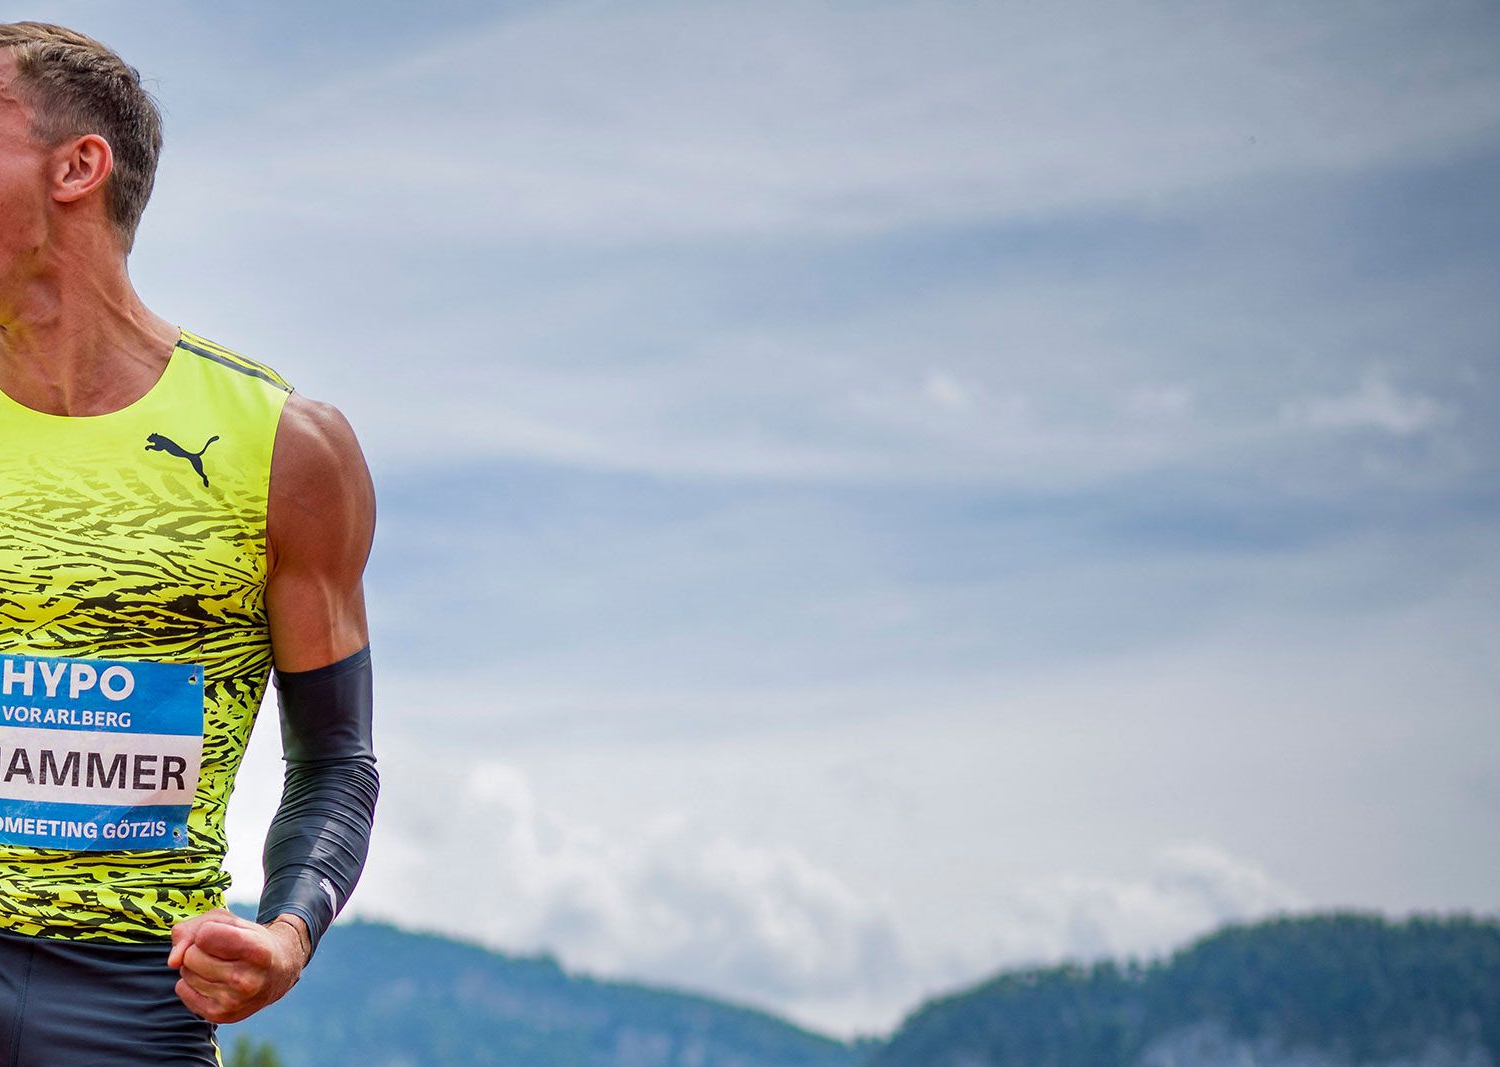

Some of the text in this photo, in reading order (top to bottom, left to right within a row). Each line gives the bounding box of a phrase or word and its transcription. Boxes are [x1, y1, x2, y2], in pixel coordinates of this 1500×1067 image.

[2, 659, 135, 701] HYPO
[2, 705, 132, 728] VORARLBERG
[102, 820, 167, 839] GÖTZIS
